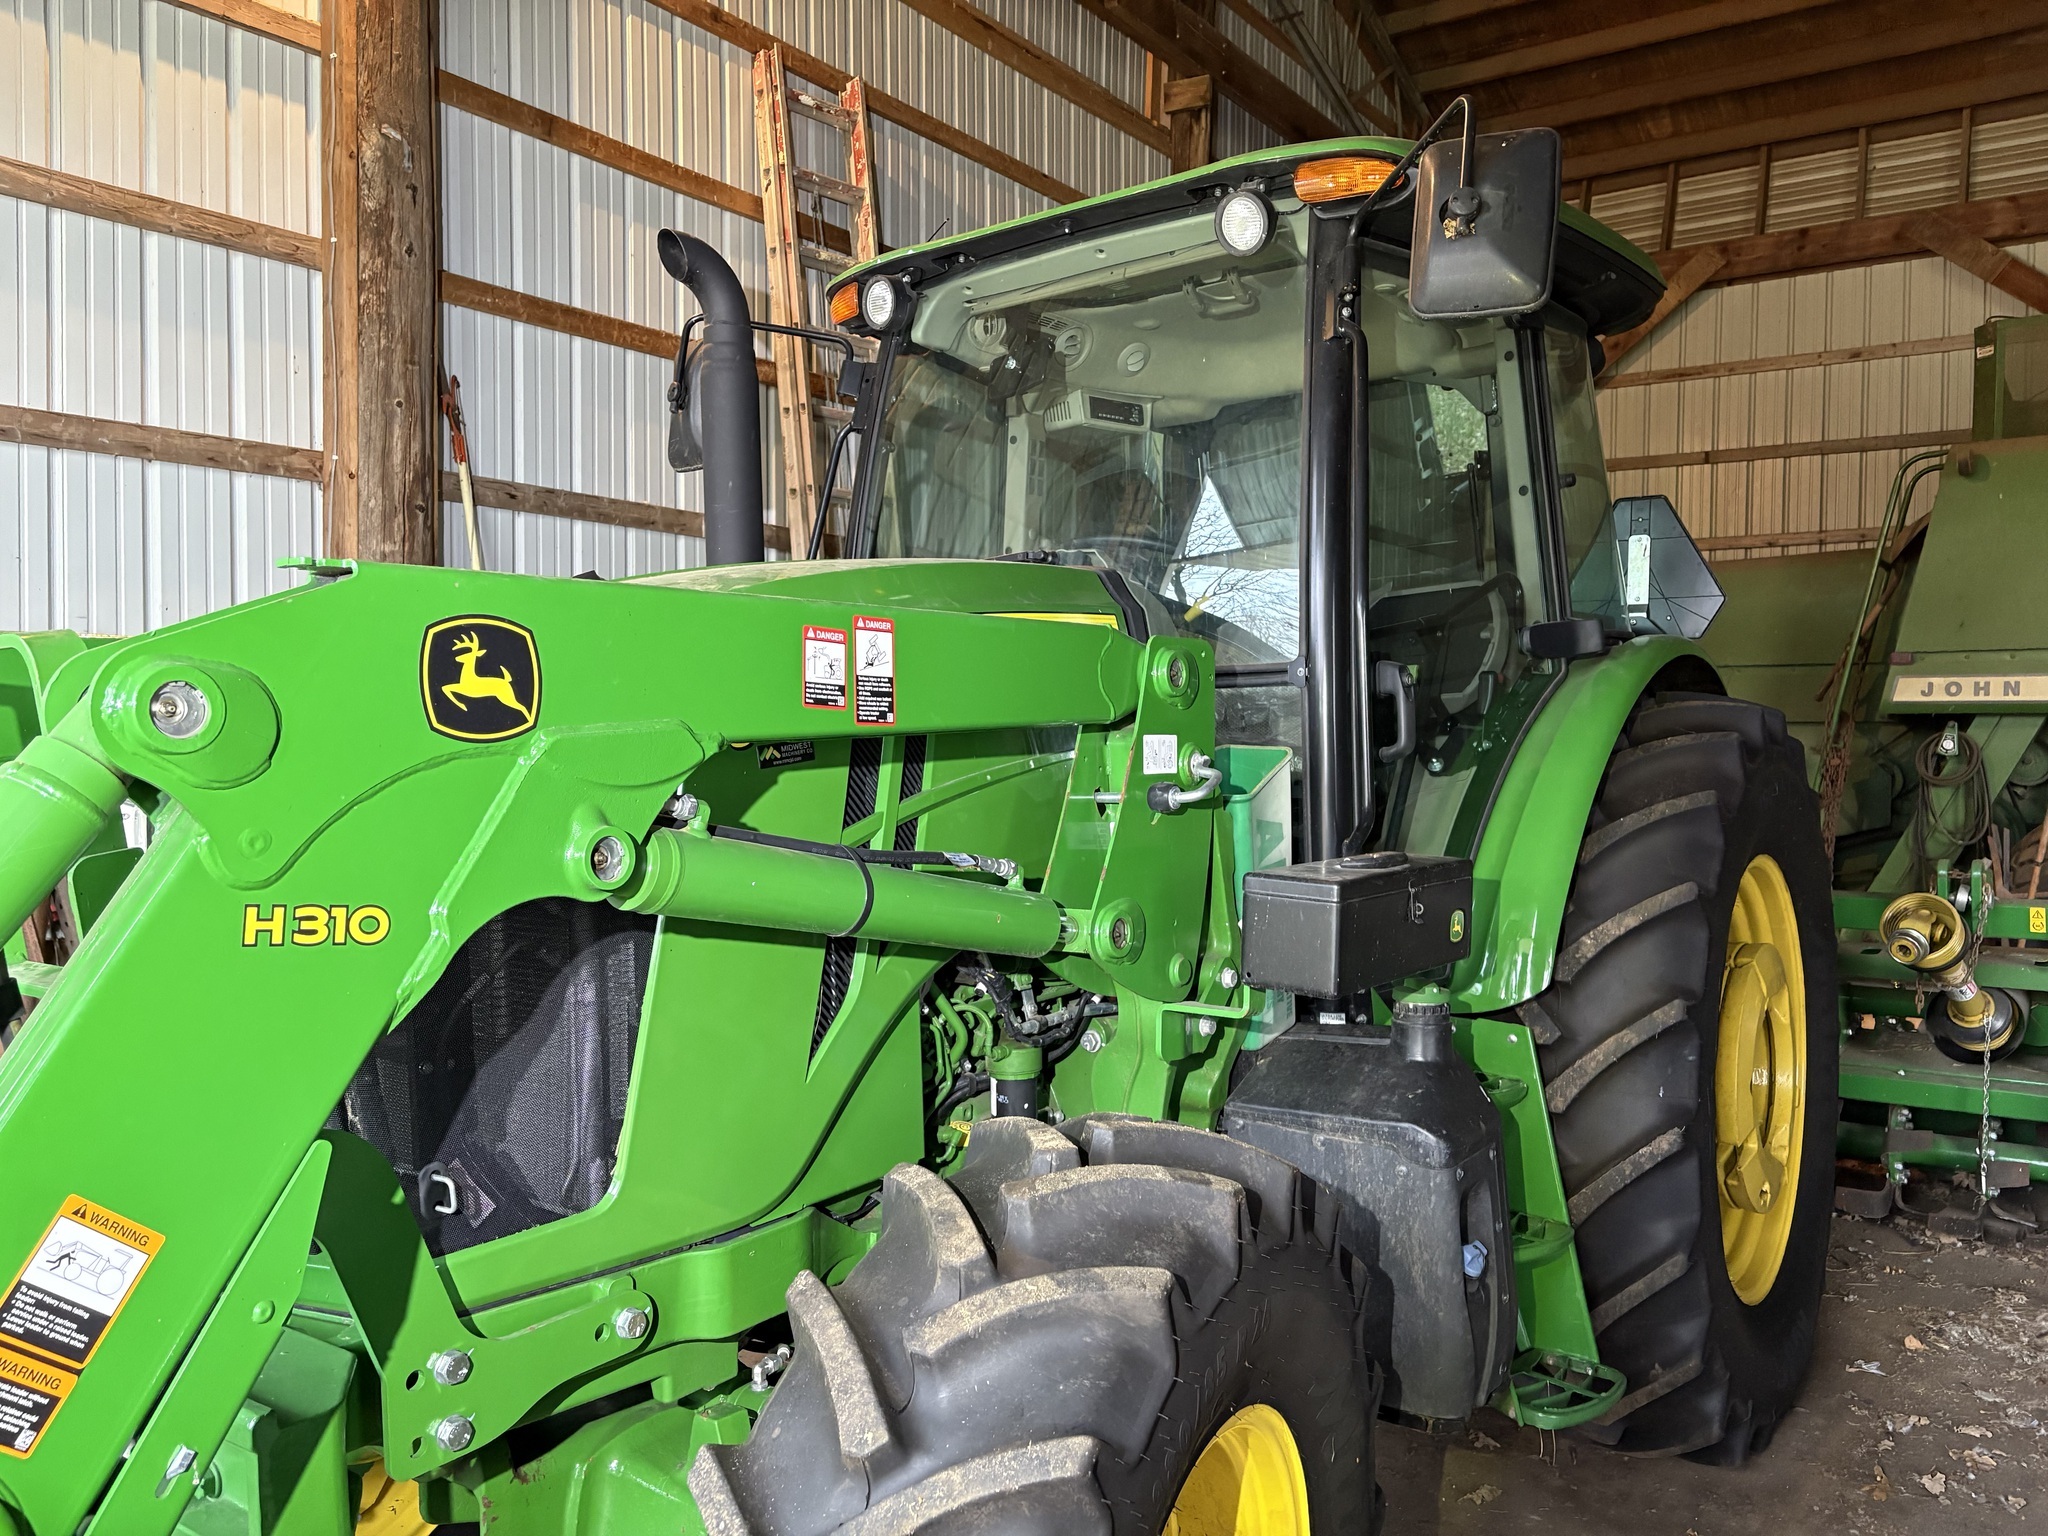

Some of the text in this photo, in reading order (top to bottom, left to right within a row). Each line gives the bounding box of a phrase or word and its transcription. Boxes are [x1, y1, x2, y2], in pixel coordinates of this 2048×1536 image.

[816, 630, 844, 642] DANGER
[866, 620, 891, 630] DANGER
[1920, 680, 2021, 696] JOHN
[780, 741, 811, 752] MIDWEST
[242, 904, 392, 948] H310
[89, 1212, 150, 1248] WARNING
[14, 1300, 25, 1308] Do
[24, 1304, 36, 1313] not
[34, 1308, 48, 1318] walk
[54, 1317, 78, 1330] perform
[20, 1284, 90, 1320] To avoid injury from falling
[6, 1314, 26, 1326] Lower
[24, 1320, 44, 1332] loader
[48, 1332, 70, 1344] ground
[69, 1339, 86, 1350] when
[11, 1308, 32, 1320] service
[32, 1316, 50, 1326] under
[53, 1324, 72, 1336] raised
[0, 1357, 62, 1390] WARNING
[10, 1386, 30, 1398] loader
[28, 1393, 50, 1405] without
